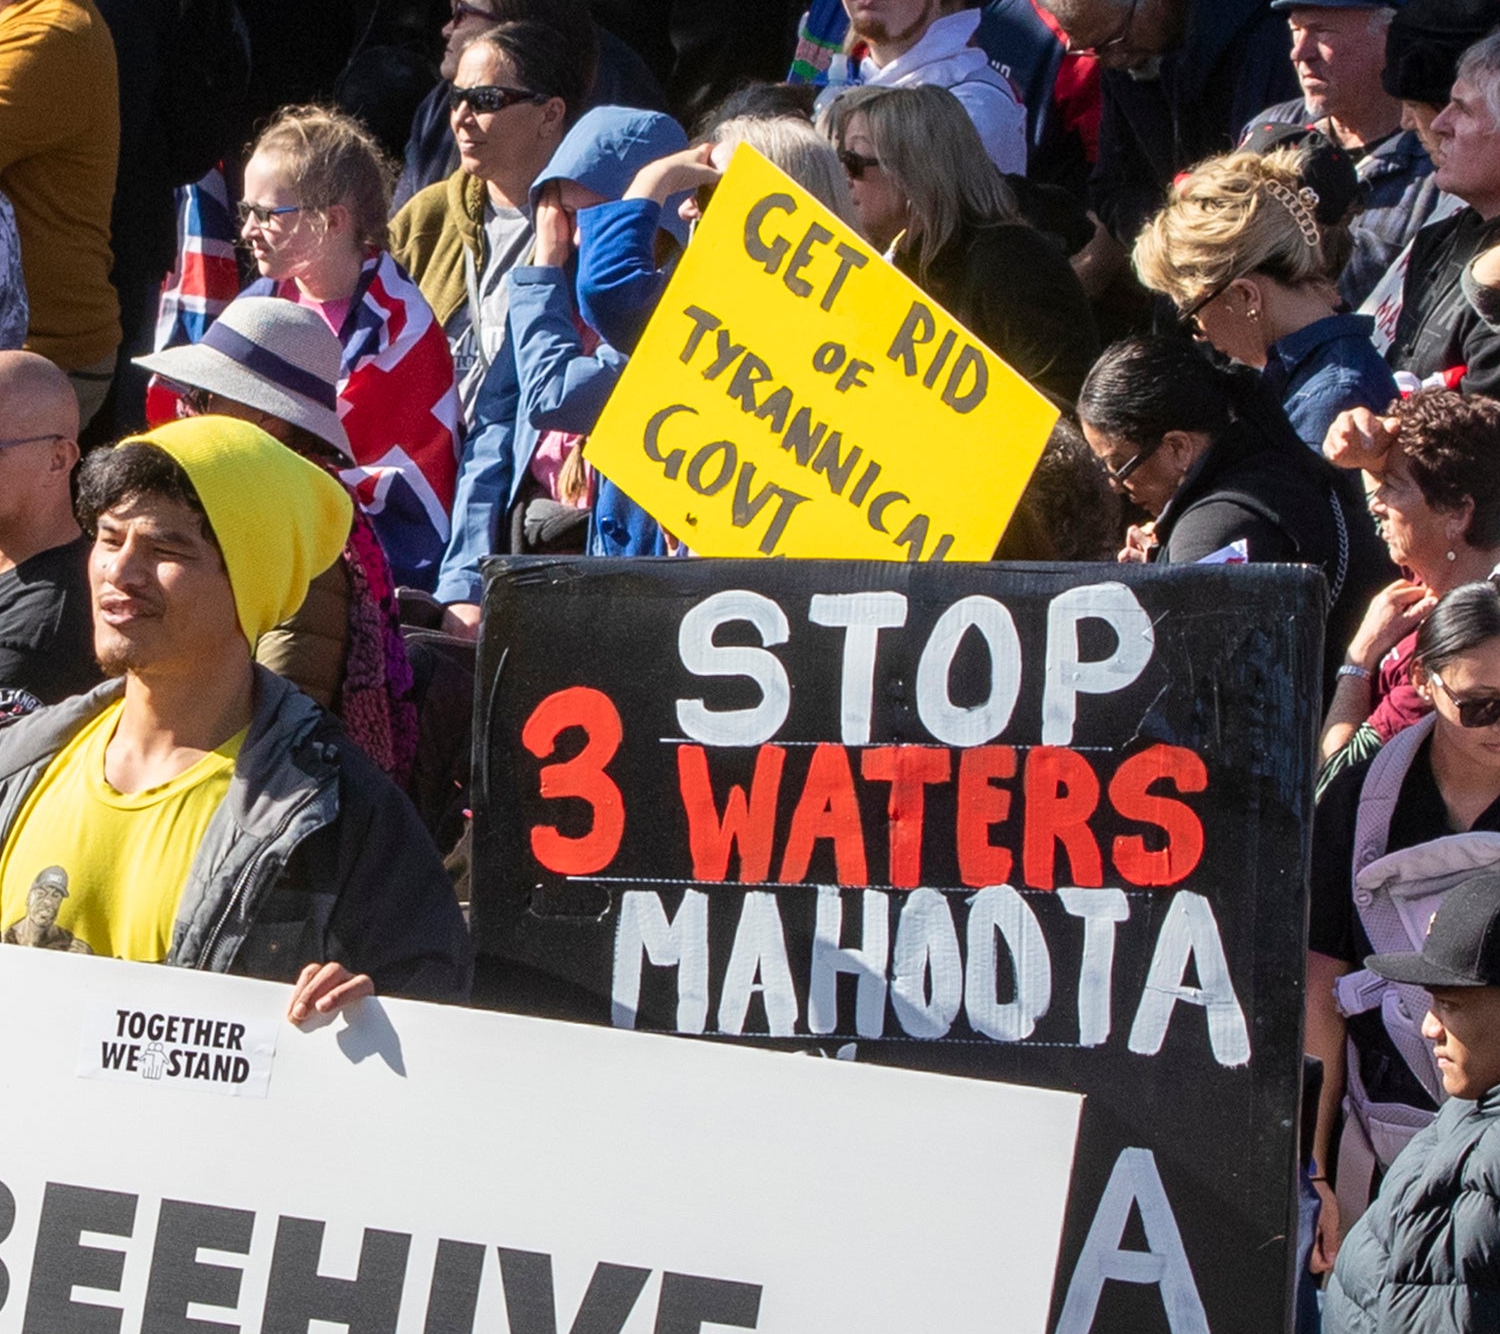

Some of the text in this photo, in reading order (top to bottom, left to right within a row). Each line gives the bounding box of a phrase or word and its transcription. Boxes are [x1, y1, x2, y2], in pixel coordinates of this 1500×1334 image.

[743, 192, 990, 416] GET RID
[812, 340, 875, 394] OF
[642, 403, 814, 557] GOVT
[675, 580, 1156, 748] STOP
[521, 685, 1209, 890] 3 WATERS
[102, 1041, 250, 1084] WE STAND
[116, 1009, 246, 1051] TOGETHER
